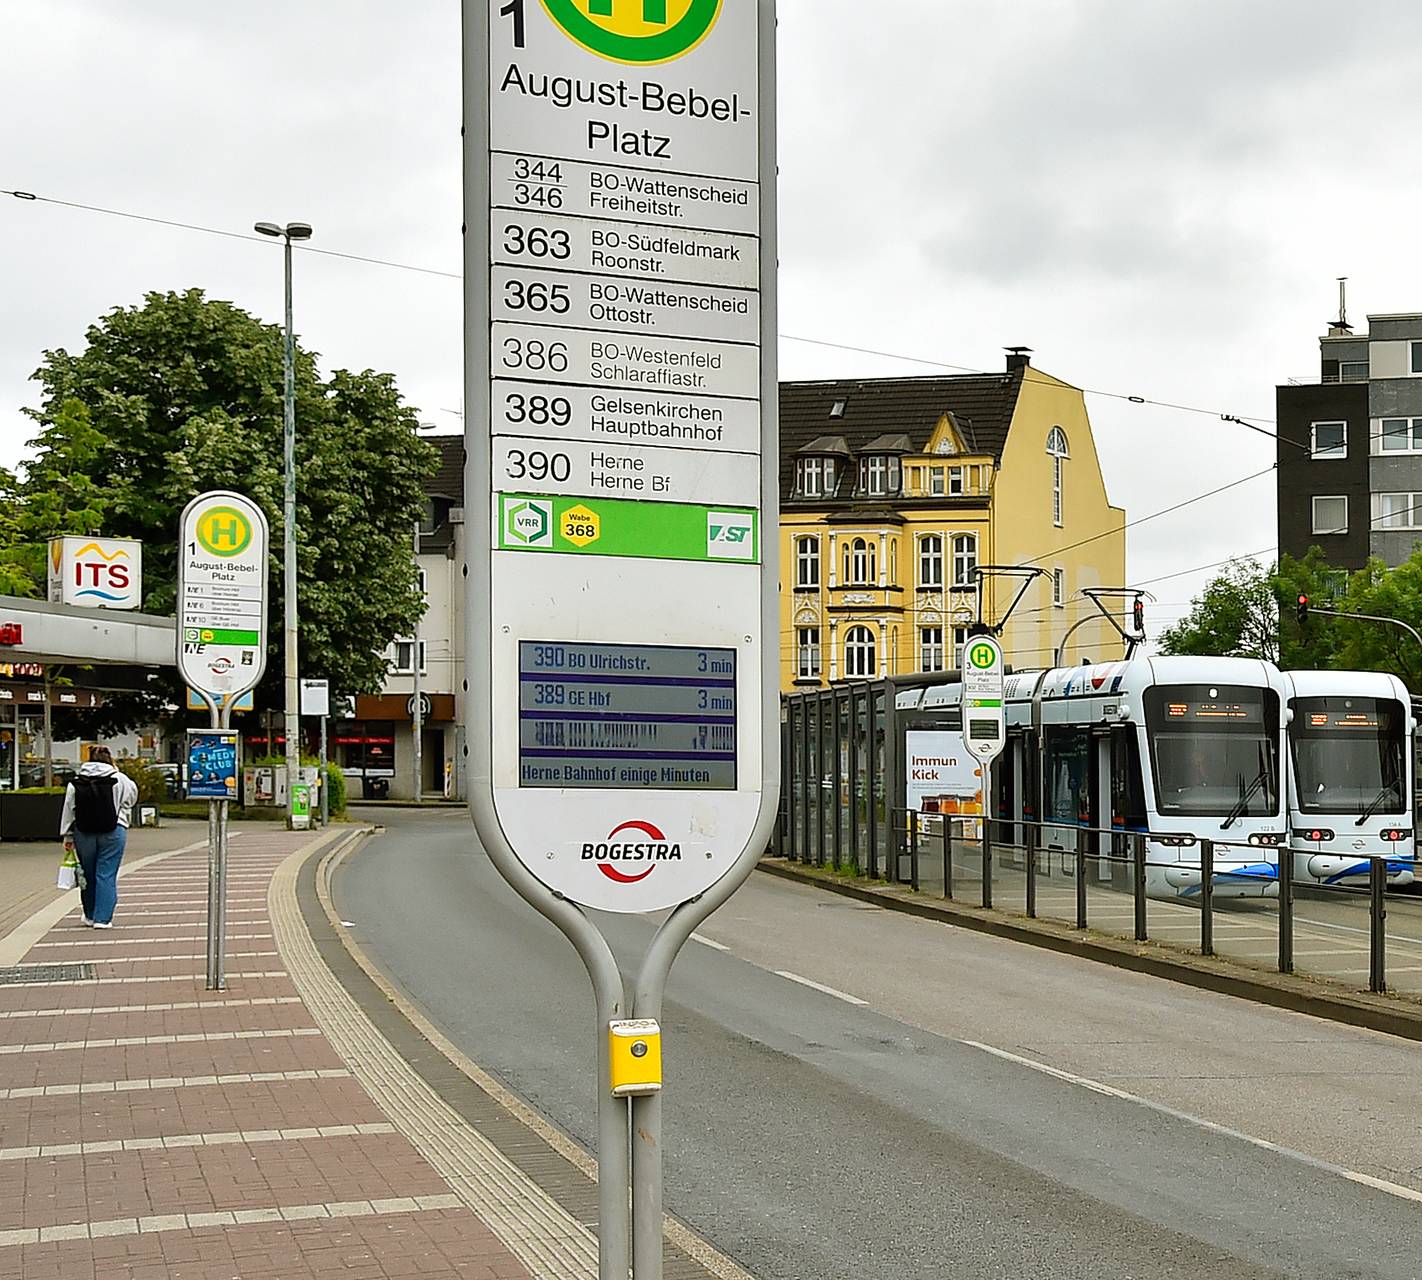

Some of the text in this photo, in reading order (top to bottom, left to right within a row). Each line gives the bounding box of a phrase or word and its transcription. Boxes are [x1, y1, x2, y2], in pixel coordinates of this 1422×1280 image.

[500, 63, 751, 122] August-Bebel-
[587, 121, 672, 159] Platz
[514, 157, 563, 183] 344
[514, 183, 563, 209] 346
[589, 171, 749, 206] BO-Wattenscheid
[589, 192, 684, 218] Freiheitstr.
[503, 224, 571, 260] 363
[591, 230, 741, 262] BO-Südfeldmark
[591, 251, 665, 273] Roonstr.
[503, 280, 571, 314] 365
[589, 283, 749, 314] BO-Wattenscheid
[589, 303, 656, 326] Ottostr.
[502, 338, 569, 373] 386
[590, 342, 722, 370] BO-Westenfeld
[590, 363, 707, 388] Schlaraffiastr.
[504, 393, 572, 427] 389
[590, 395, 723, 422] Gelsenkirchen
[590, 416, 723, 441] Hauptbahnhof
[506, 450, 571, 482] 390
[590, 451, 645, 472] Herne
[590, 471, 671, 493] Herne Bf
[517, 516, 540, 528] VRR
[568, 512, 591, 523] Wabe
[565, 523, 596, 538] 368
[187, 541, 197, 556] 1
[75, 561, 129, 588] ITS
[189, 560, 259, 573] August-Bebel-
[211, 571, 236, 582] Platz
[534, 646, 733, 674] 390 BO Ulrichstr. 3 min
[966, 662, 972, 670] 3
[534, 684, 733, 711] 389 GE Hbf 3 min
[189, 750, 235, 764] CMEDY
[911, 755, 957, 767] Immun
[521, 765, 710, 786] Herne Bahnhof einige Minuten
[911, 769, 939, 780] Kick
[580, 843, 682, 861] BOGESTRA
